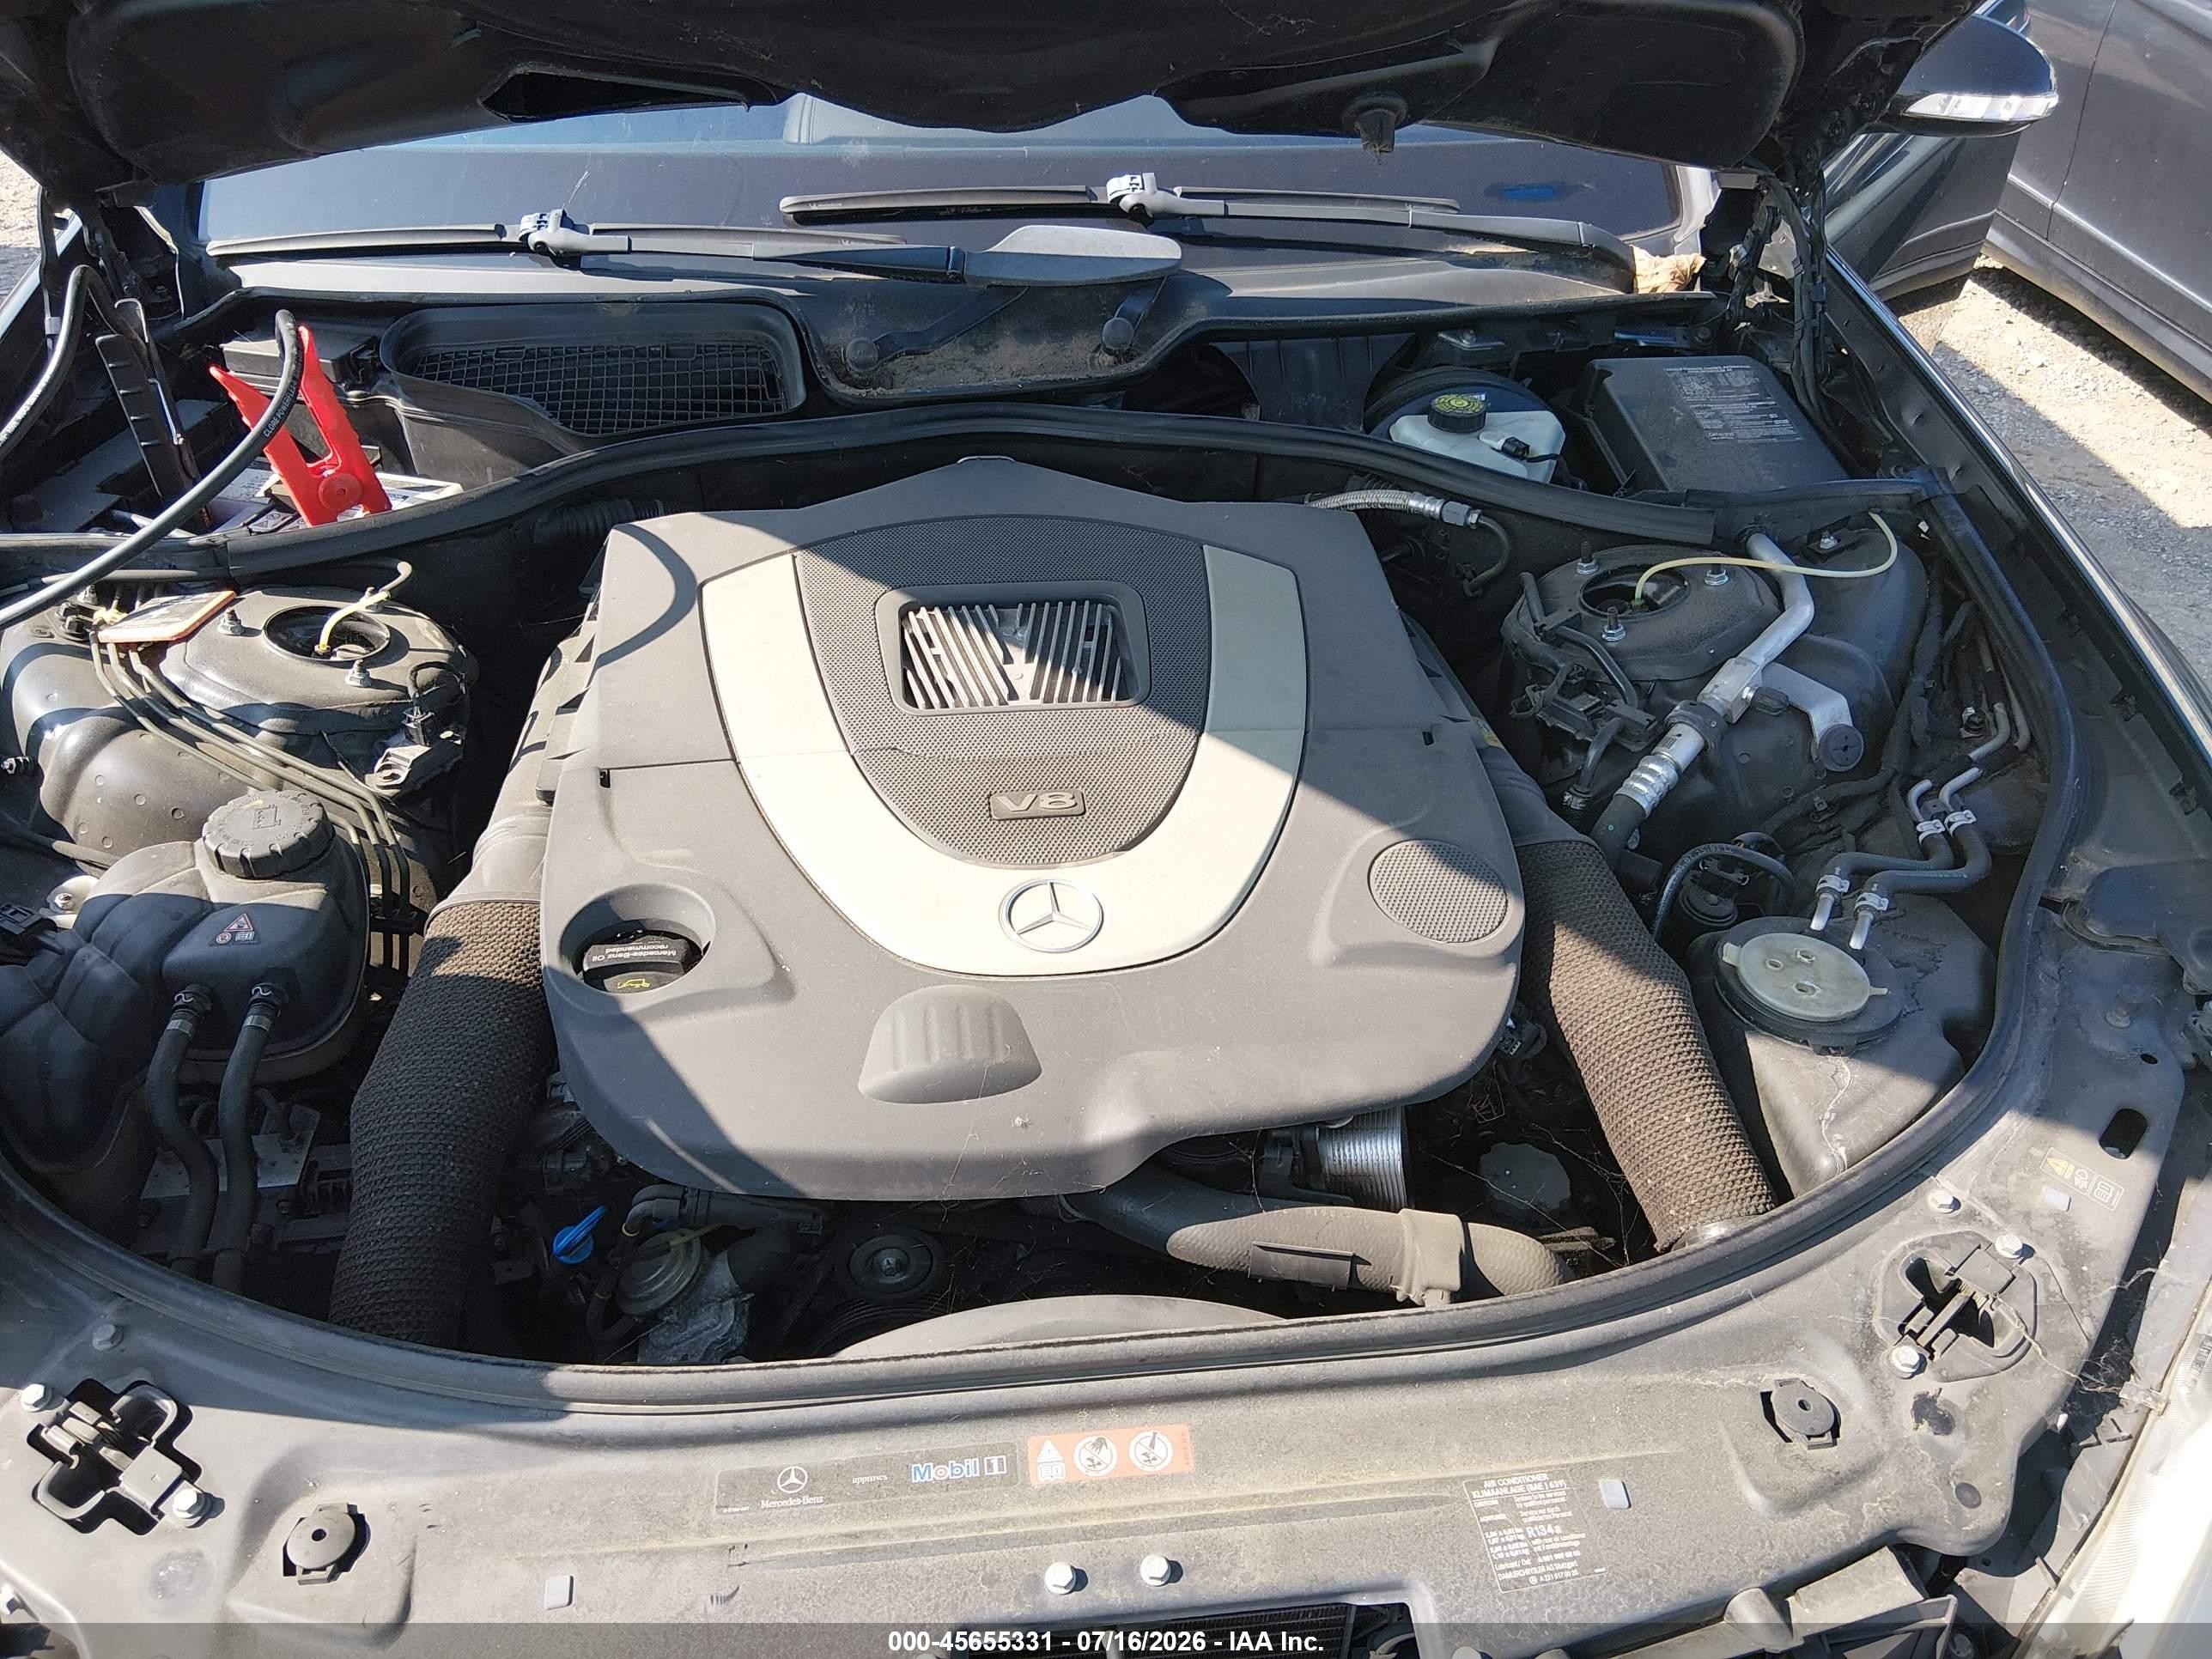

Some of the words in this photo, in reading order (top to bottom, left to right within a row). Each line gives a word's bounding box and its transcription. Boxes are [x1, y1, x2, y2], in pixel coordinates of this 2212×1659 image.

[263, 416, 278, 437] CLORE
[996, 792, 1078, 811] V8
[605, 945, 669, 954] recommended
[607, 950, 677, 959] Mercedes-Benz
[911, 1458, 980, 1483] Mobil
[852, 1473, 888, 1485] approves
[1483, 1480, 1498, 1489] AIR
[1498, 1474, 1549, 1486] CONDITIONER
[1471, 1485, 1526, 1499] KLIMAANLAGE
[761, 1496, 825, 1509] Mercedes-Benz
[1526, 1523, 1562, 1538] R134a
